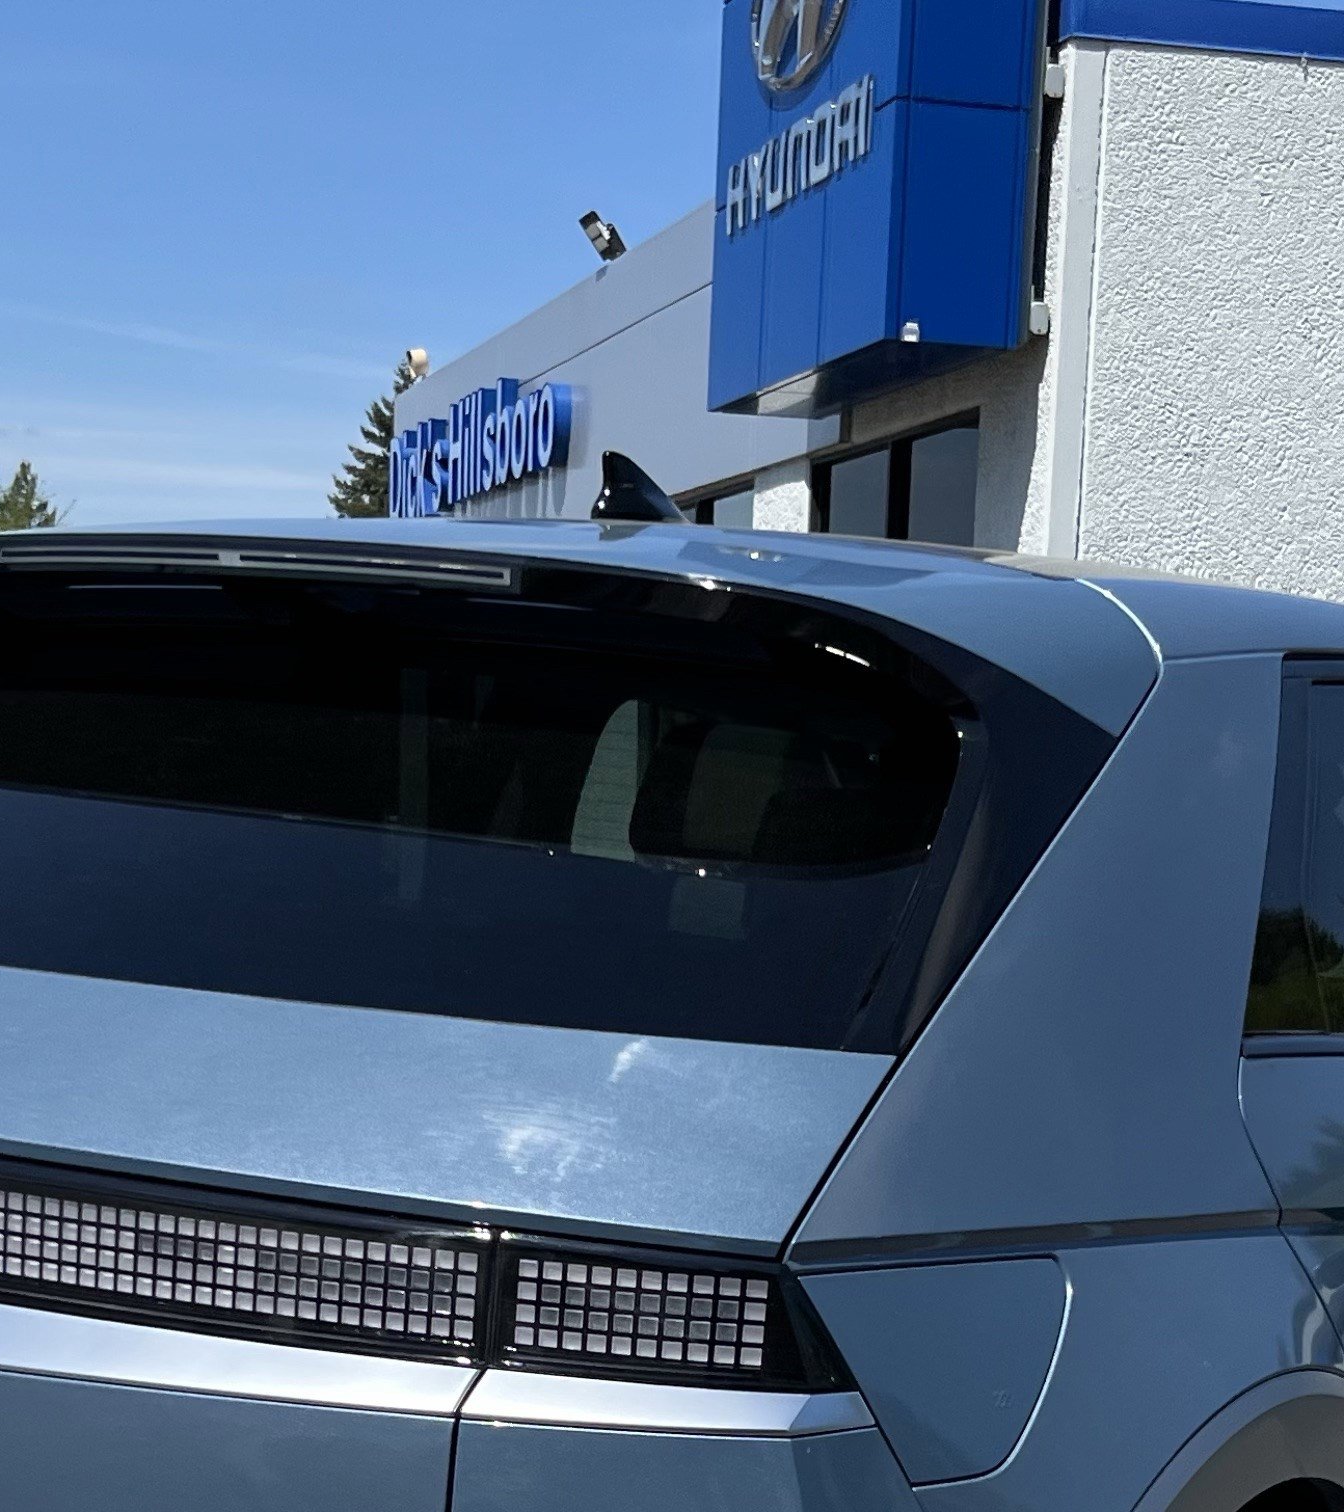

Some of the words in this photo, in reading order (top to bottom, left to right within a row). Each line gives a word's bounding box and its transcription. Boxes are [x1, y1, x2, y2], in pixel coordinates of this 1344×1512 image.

[726, 73, 873, 236] HYUNDAI
[389, 417, 443, 518] Dick's
[446, 377, 556, 505] Hillsboro
